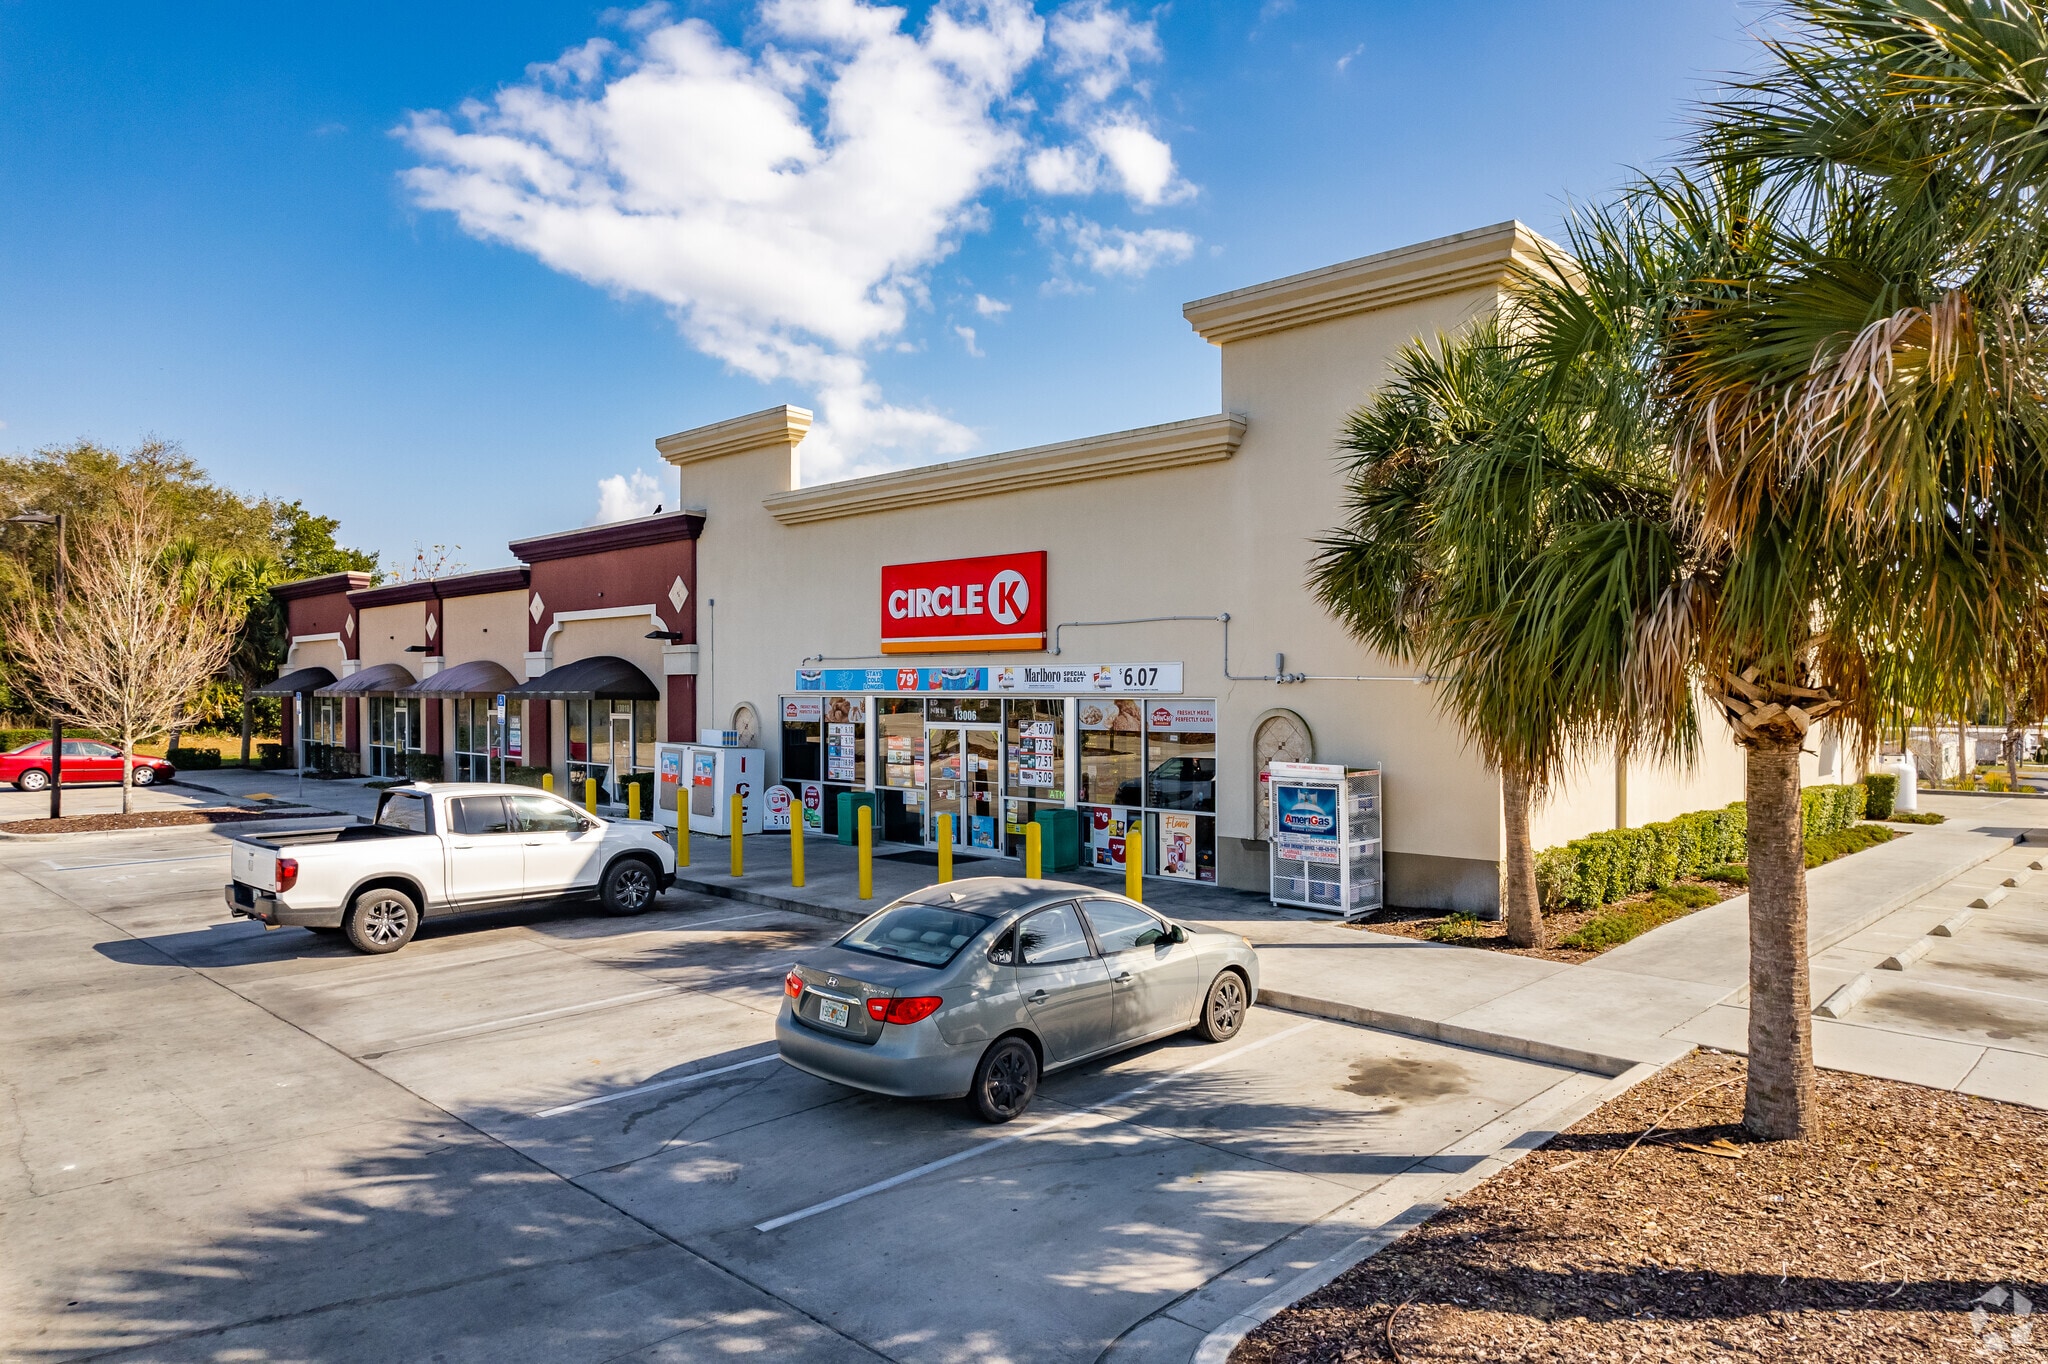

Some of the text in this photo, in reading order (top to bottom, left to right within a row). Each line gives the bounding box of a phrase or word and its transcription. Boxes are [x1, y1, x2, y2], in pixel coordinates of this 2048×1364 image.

[888, 584, 984, 620] CIRCLE
[1024, 668, 1061, 683] Marlboro
[954, 710, 977, 721] 13006
[1049, 790, 1066, 799] ATM
[1165, 815, 1190, 829] Flavor
[1285, 814, 1330, 826] AmeriGas
